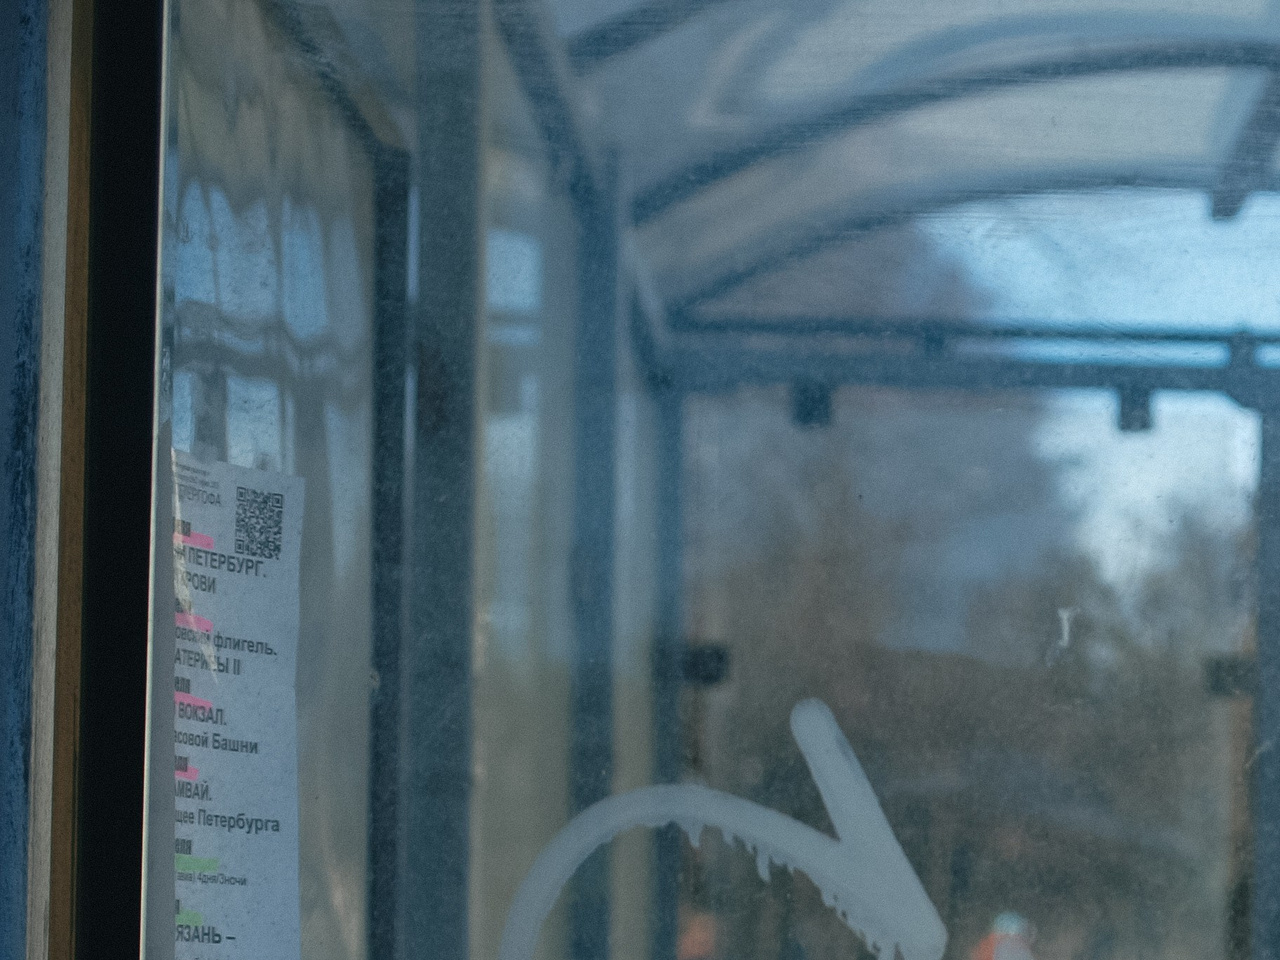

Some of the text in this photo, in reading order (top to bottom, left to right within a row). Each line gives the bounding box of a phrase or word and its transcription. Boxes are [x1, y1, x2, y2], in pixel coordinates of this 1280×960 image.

[188, 546, 267, 577] ПЕТЕРБУРГ.
[180, 569, 217, 595] РОВИ
[213, 630, 278, 656] флигель.
[178, 701, 228, 726] ВОКЗАЛ.
[211, 732, 259, 755] Башни
[197, 809, 280, 835] Петербурга
[176, 923, 222, 945] ЯЗАНЬ
